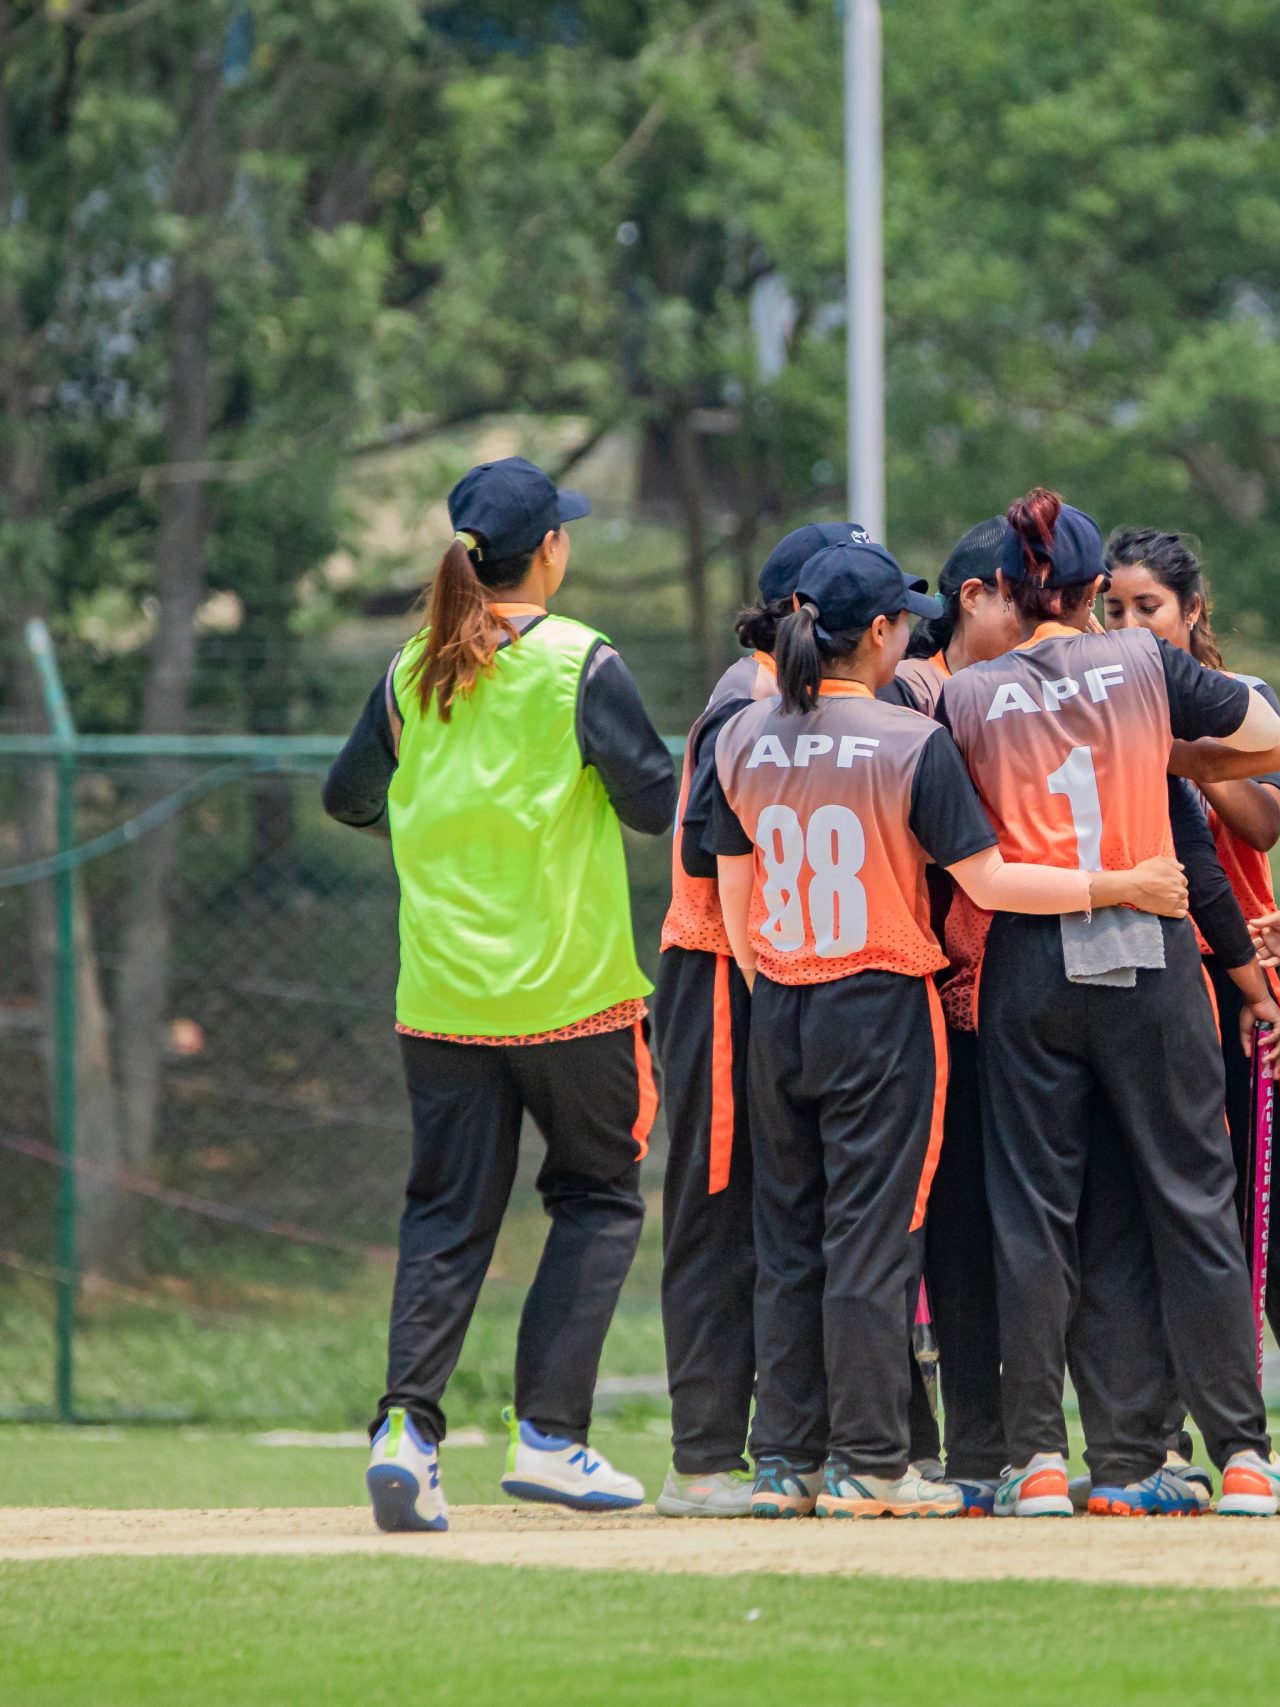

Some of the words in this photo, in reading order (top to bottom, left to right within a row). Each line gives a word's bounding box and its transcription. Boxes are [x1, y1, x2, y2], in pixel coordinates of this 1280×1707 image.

[985, 663, 1125, 721] APF
[745, 734, 880, 769] APF
[1047, 745, 1101, 871] 1
[755, 804, 868, 959] 88
